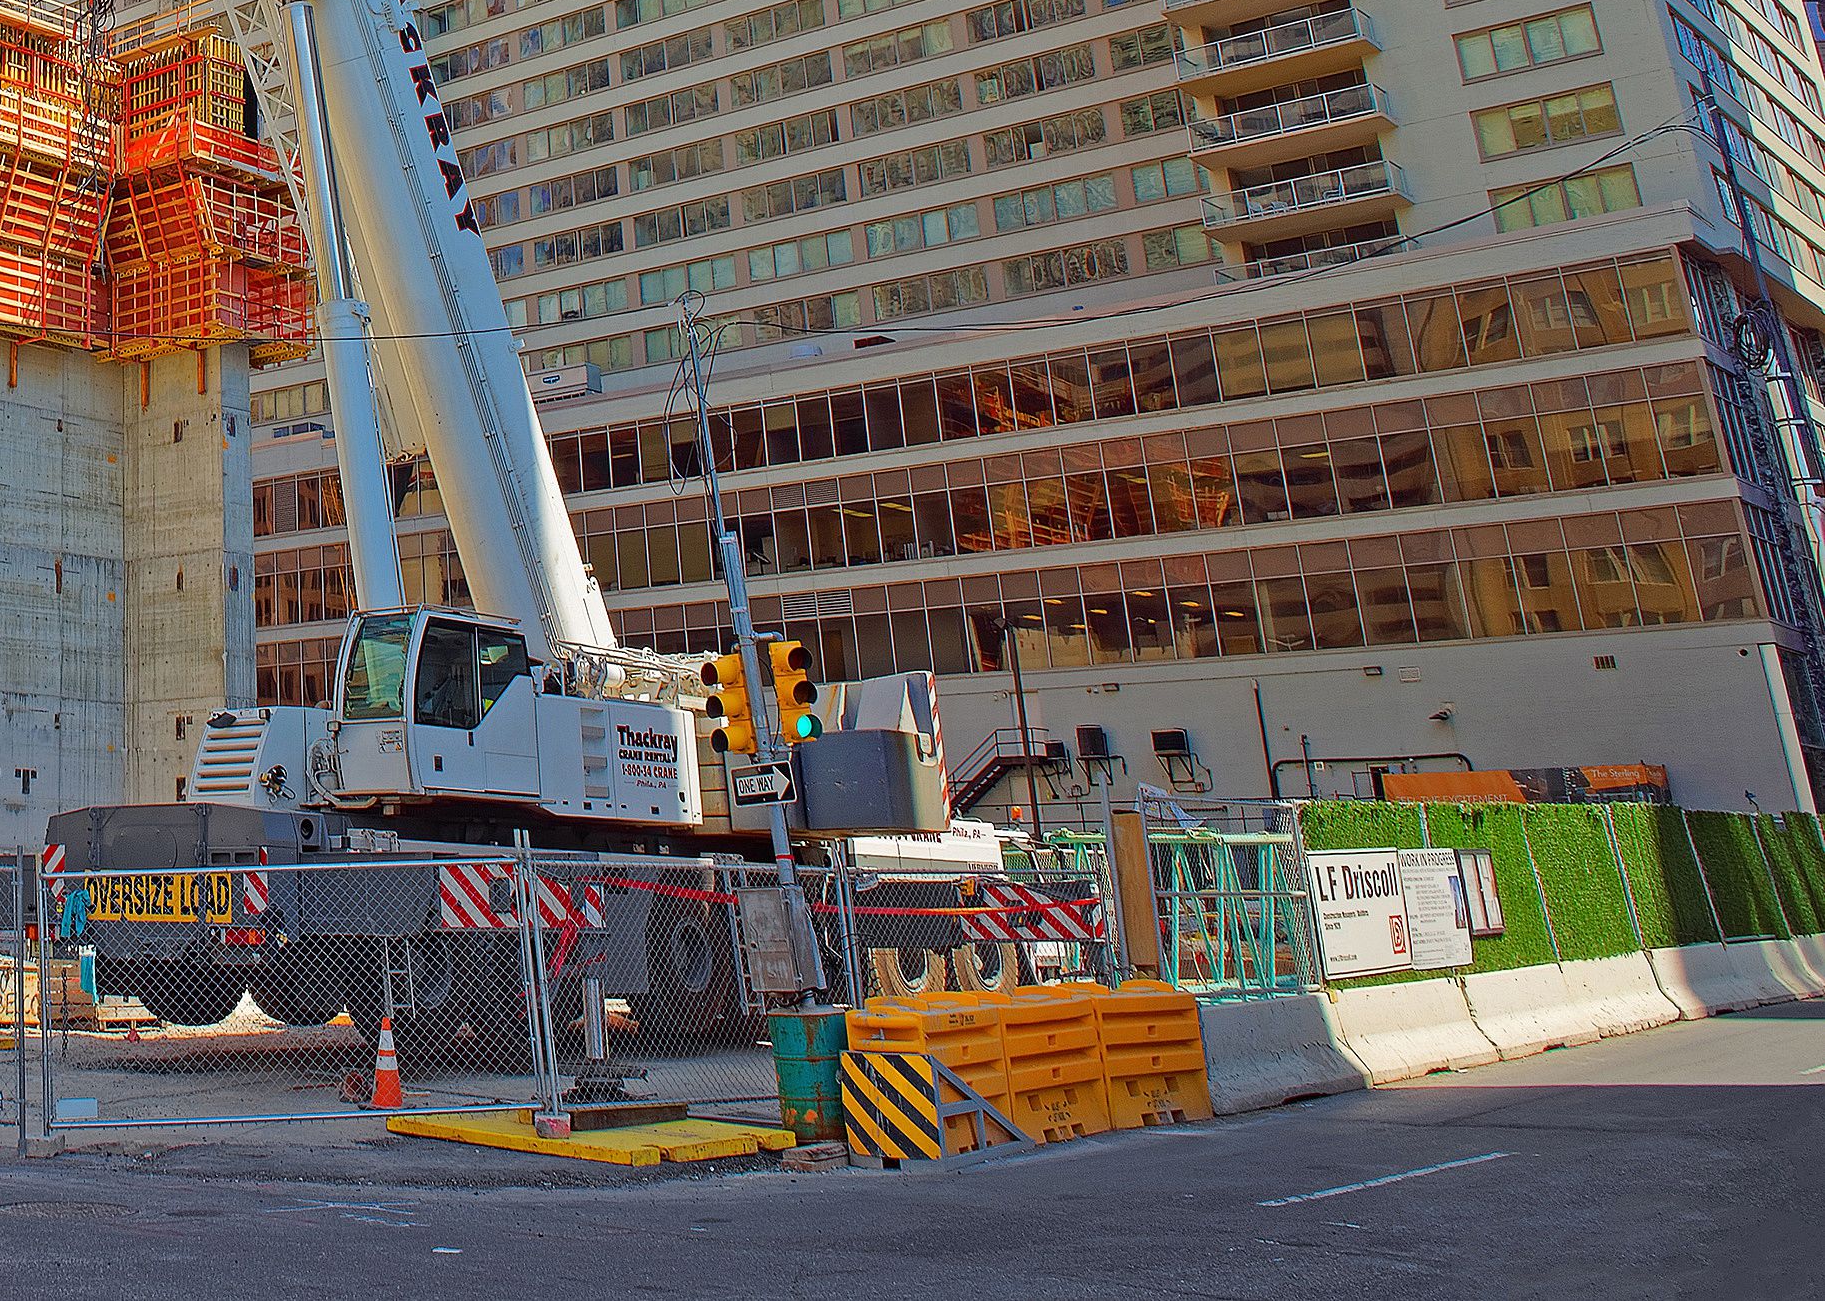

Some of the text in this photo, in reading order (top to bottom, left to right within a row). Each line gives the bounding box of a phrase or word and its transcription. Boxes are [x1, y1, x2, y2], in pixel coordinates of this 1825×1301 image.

[617, 725, 678, 763] Thackray
[618, 748, 671, 763] CRANE RENTAL
[621, 765, 678, 780] 1-800-34 CRANE
[1591, 769, 1608, 778] The
[1609, 768, 1640, 778] Sterling
[658, 781, 667, 789] PA
[738, 775, 774, 795] ONE WAY
[1400, 851, 1455, 868] WORK IN PROGRESS
[1315, 862, 1399, 902] LF Driscoll
[86, 874, 230, 916] OVERSIZE LOAD
